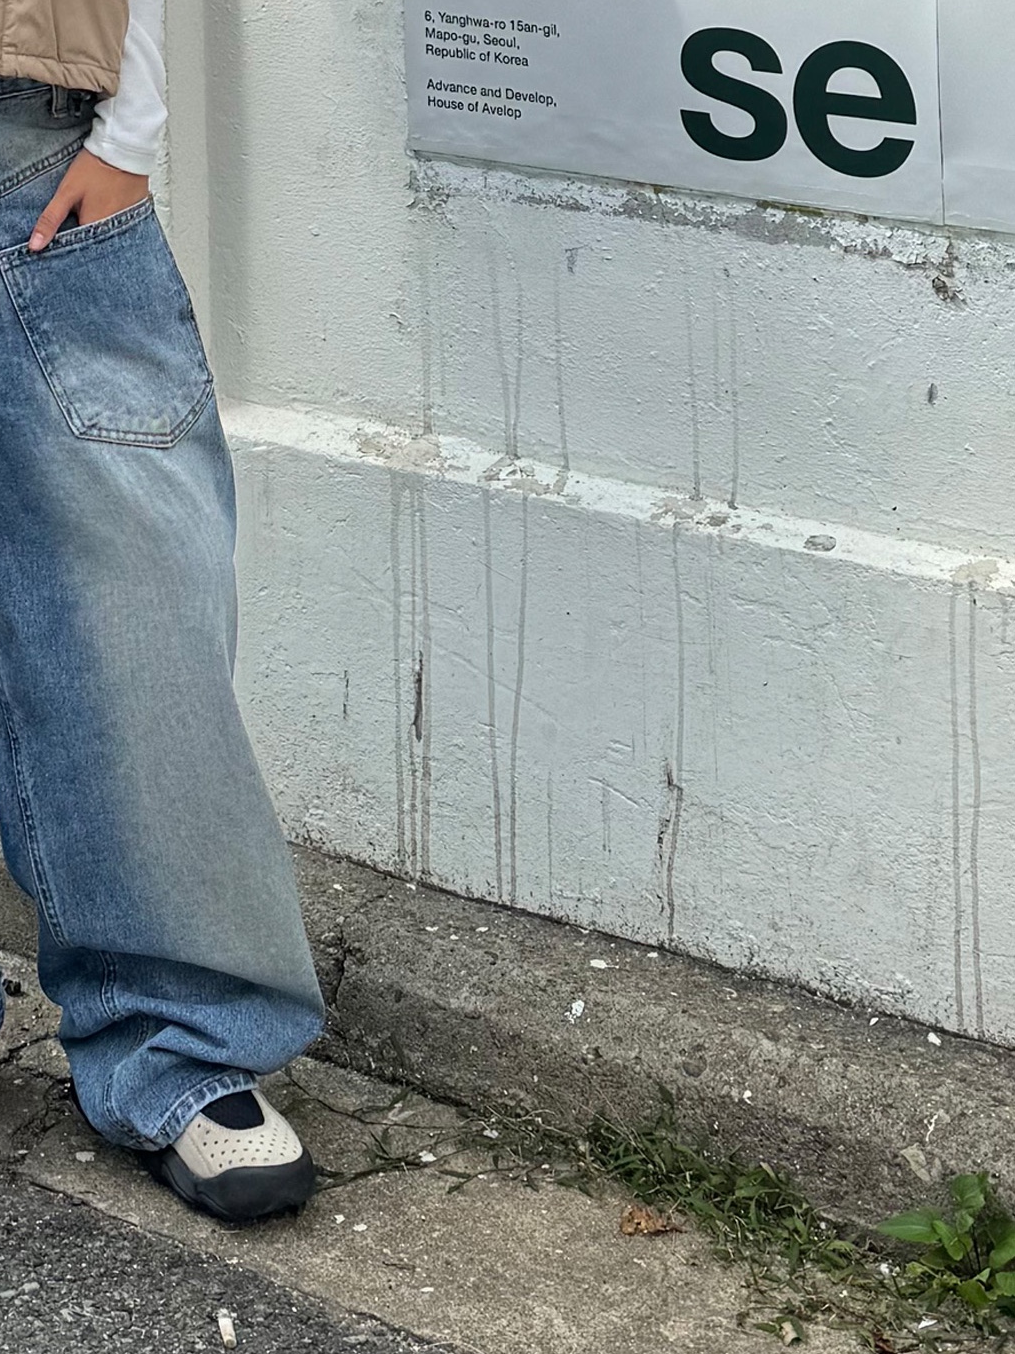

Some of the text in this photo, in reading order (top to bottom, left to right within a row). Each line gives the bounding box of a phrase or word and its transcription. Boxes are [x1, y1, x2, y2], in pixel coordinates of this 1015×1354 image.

[424, 10, 560, 38] 6, Yanghwa-ro 15an-gil,
[425, 27, 520, 50] Mapo-gu, Seoul,
[425, 43, 529, 67] Republic of Korea
[426, 78, 557, 107] Advance and Develop,
[680, 27, 917, 178] se
[427, 95, 522, 120] House of Avelop
